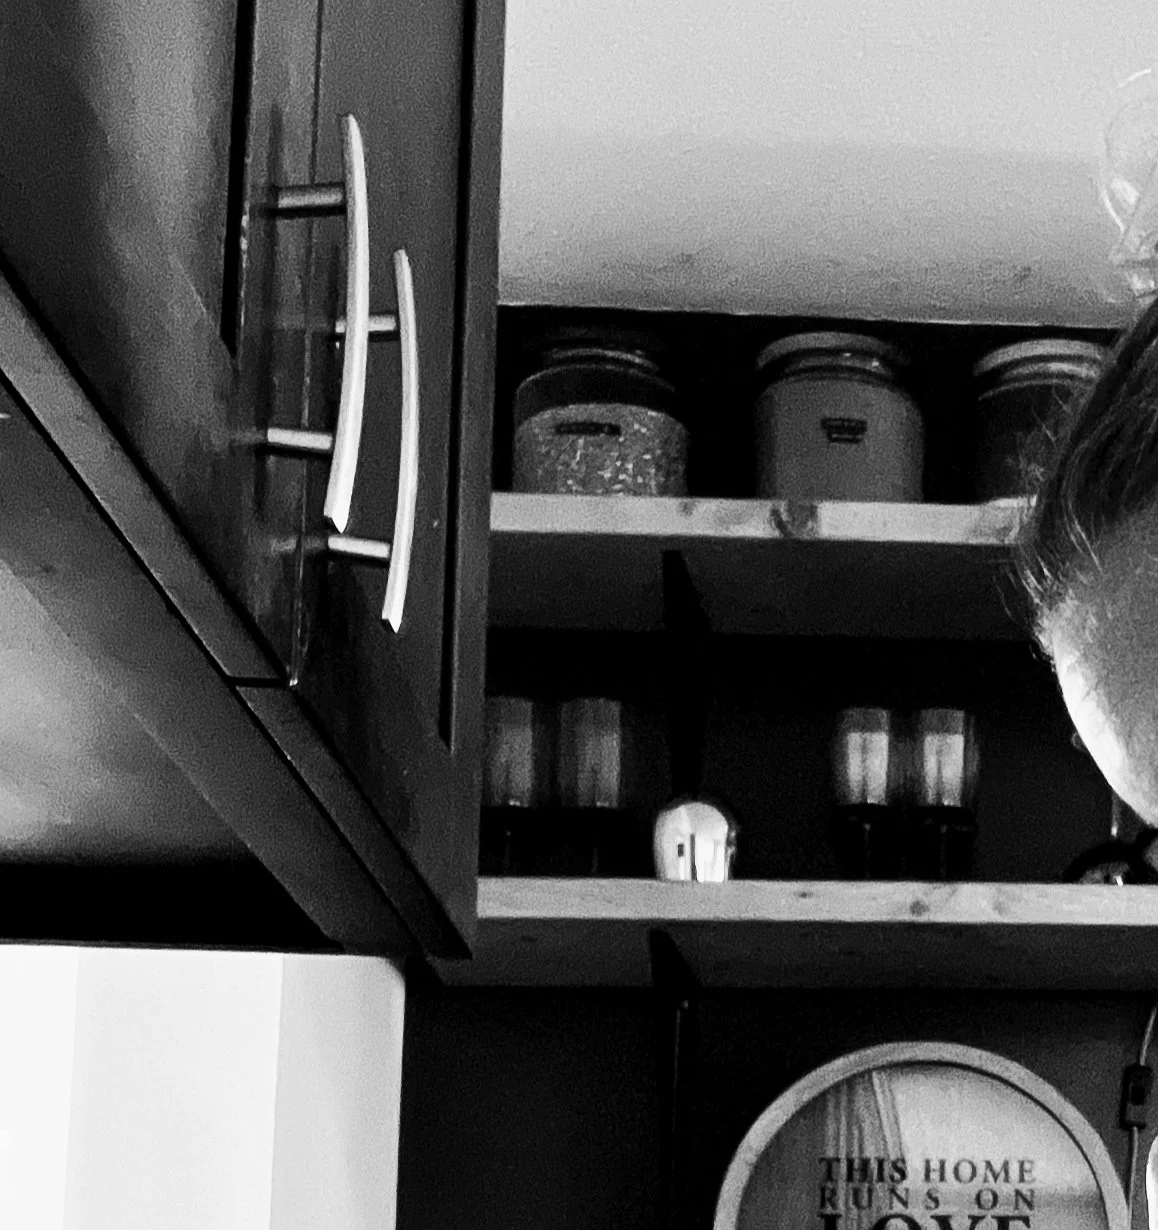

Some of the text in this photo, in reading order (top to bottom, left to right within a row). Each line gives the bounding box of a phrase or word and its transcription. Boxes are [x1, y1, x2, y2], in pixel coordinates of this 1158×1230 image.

[818, 1157, 1037, 1185] THIS HOME
[818, 1187, 1037, 1212] RUNS ON
